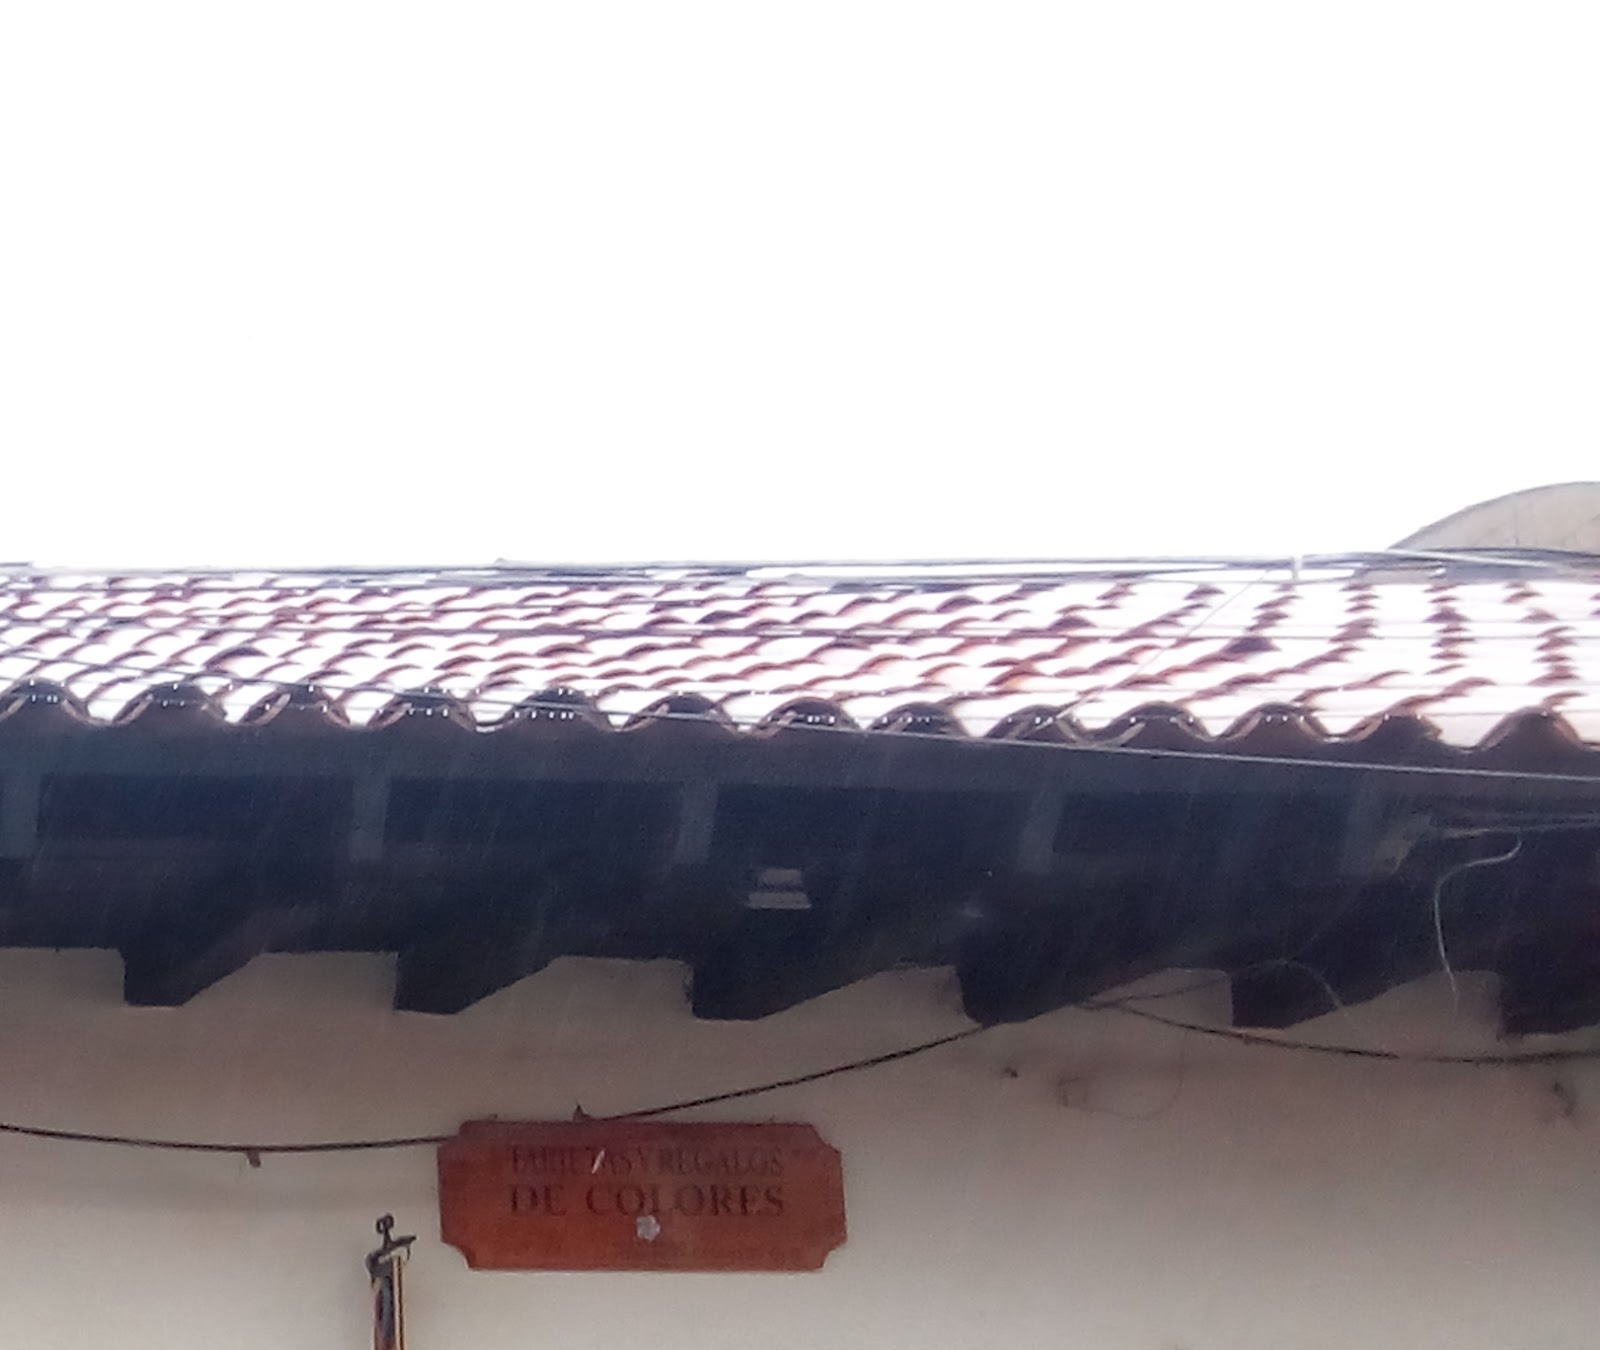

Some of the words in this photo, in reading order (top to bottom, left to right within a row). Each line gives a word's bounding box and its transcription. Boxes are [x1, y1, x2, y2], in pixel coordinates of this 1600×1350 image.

[659, 1147, 785, 1175] REGALOS
[509, 1183, 568, 1216] DE
[585, 1183, 785, 1217] COLORES
